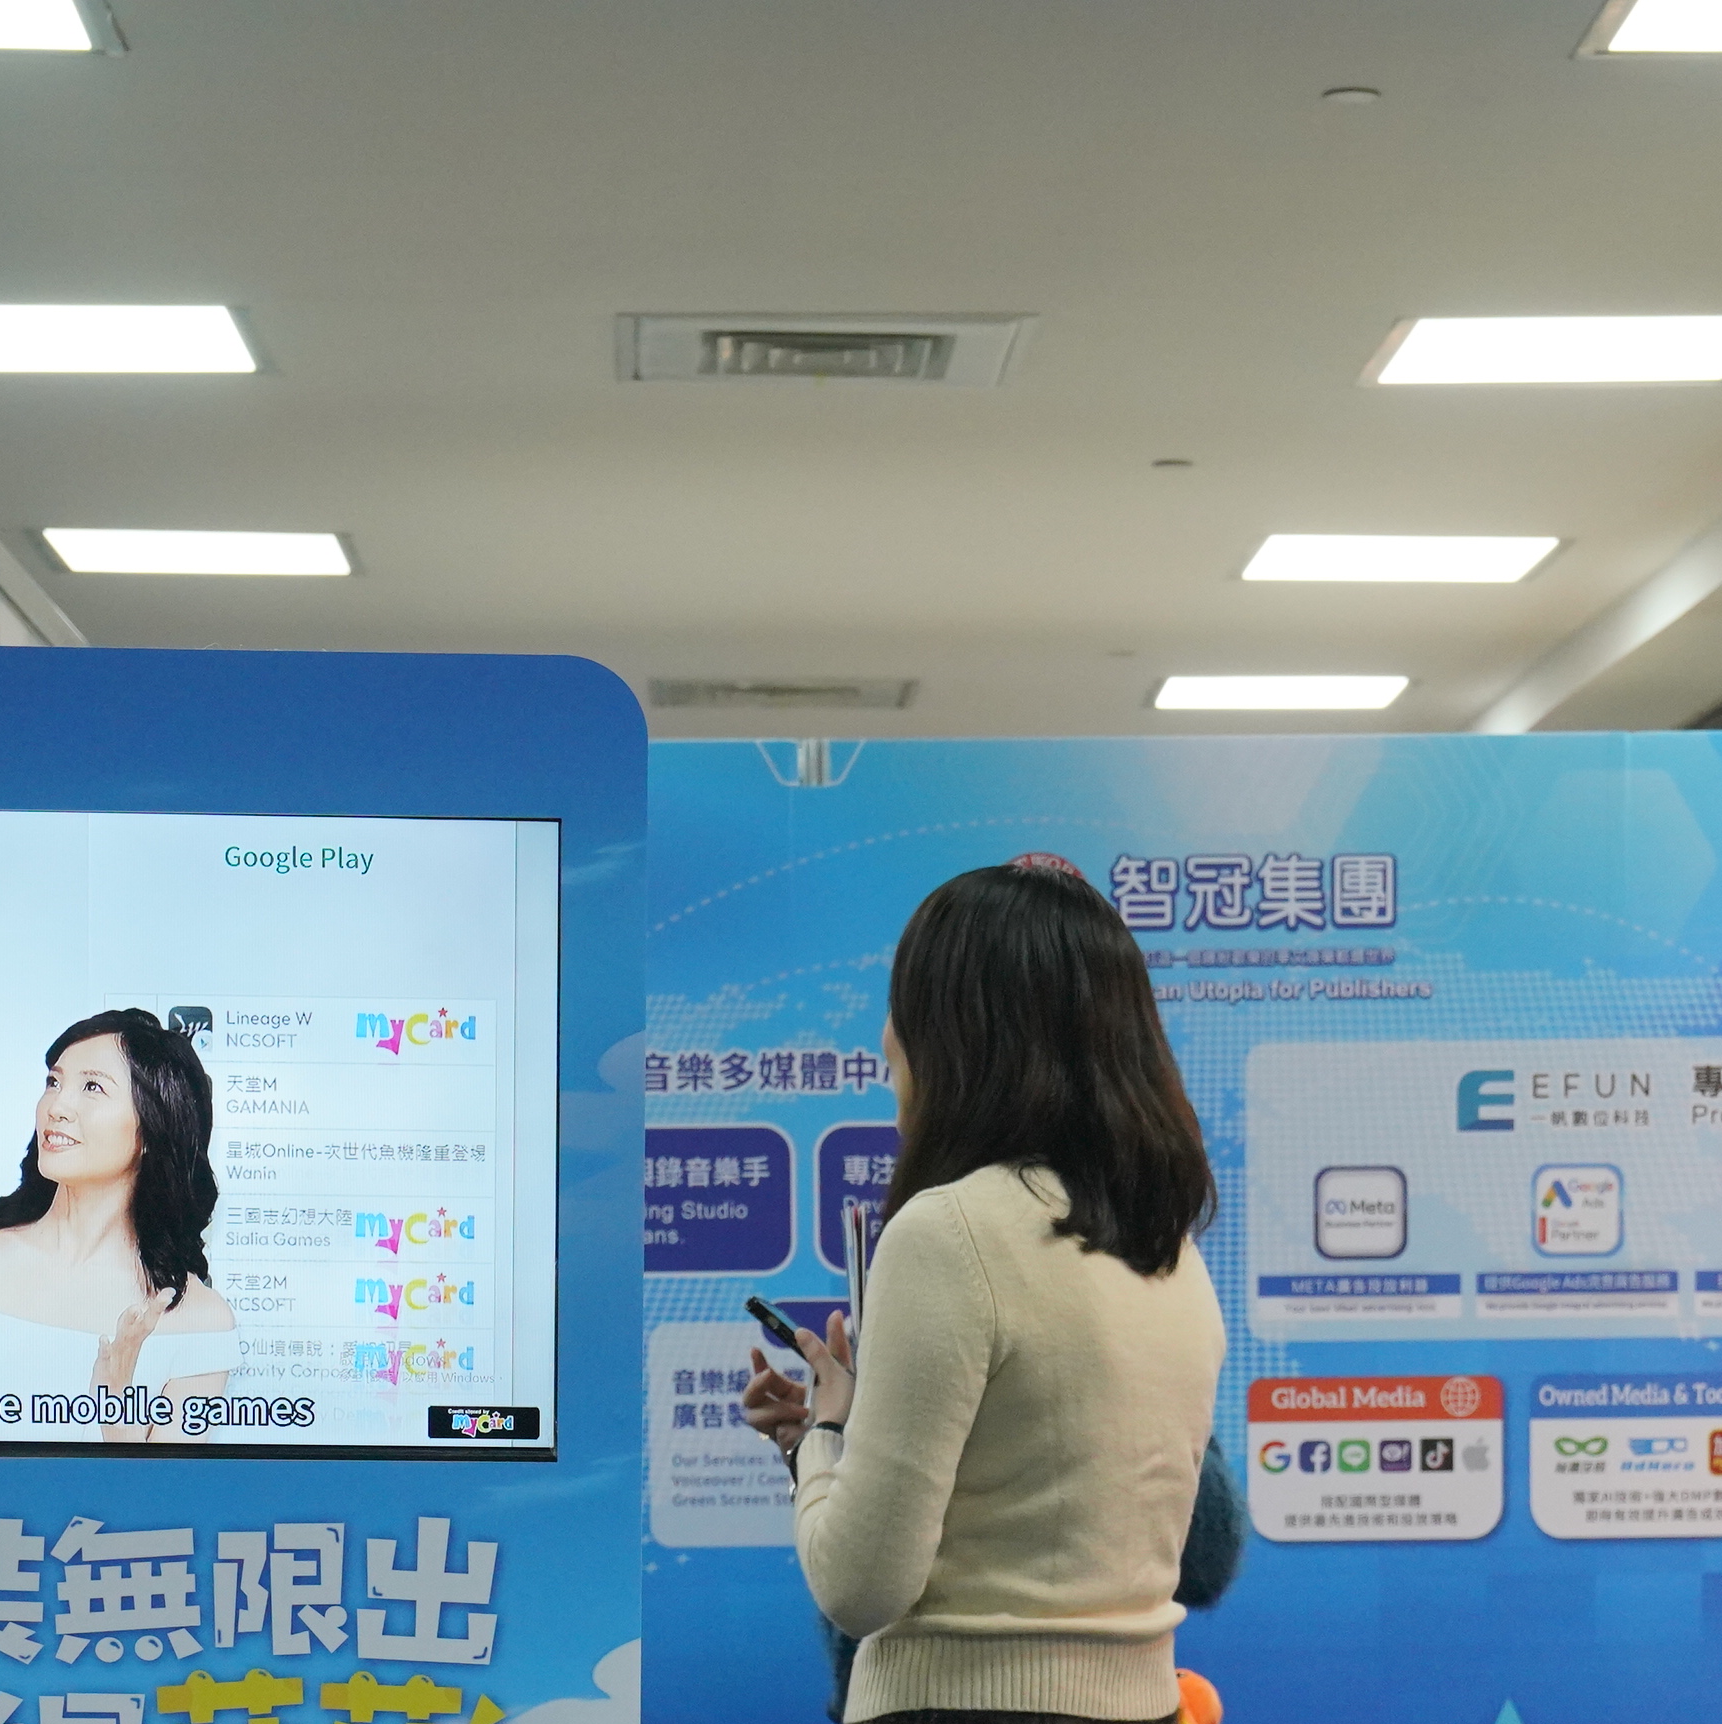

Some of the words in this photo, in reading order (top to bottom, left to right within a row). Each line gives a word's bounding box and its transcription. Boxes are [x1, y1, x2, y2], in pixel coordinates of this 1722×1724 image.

[223, 845, 314, 875] Google
[320, 846, 375, 876] Play
[1111, 853, 1397, 930] 智冠集團
[1188, 981, 1264, 1005] Utopia
[1269, 979, 1304, 1001] for
[1309, 978, 1432, 1001] Publishers
[226, 1010, 291, 1029] Lineage
[295, 1011, 313, 1026] W
[226, 1033, 298, 1049] NCSOFT
[645, 1052, 890, 1092] 音樂多媒體中
[227, 1075, 278, 1093] 天堂M
[1531, 1073, 1651, 1099] EFUN
[226, 1099, 310, 1115] GAMANIA
[226, 1166, 277, 1180] Wanin
[226, 1206, 353, 1227] 三國志幻想大陸
[681, 1200, 749, 1220] Studio
[1349, 1199, 1396, 1216] Meta
[226, 1232, 269, 1247] Sialia
[273, 1232, 332, 1248] Games
[226, 1273, 288, 1291] 天堂2M
[1270, 1385, 1347, 1410] Global
[1352, 1384, 1426, 1409] Media
[1538, 1384, 1608, 1408] Owned
[1611, 1383, 1670, 1407] Media
[1674, 1383, 1690, 1406] &
[30, 1385, 175, 1425] mobile
[182, 1394, 315, 1435] games
